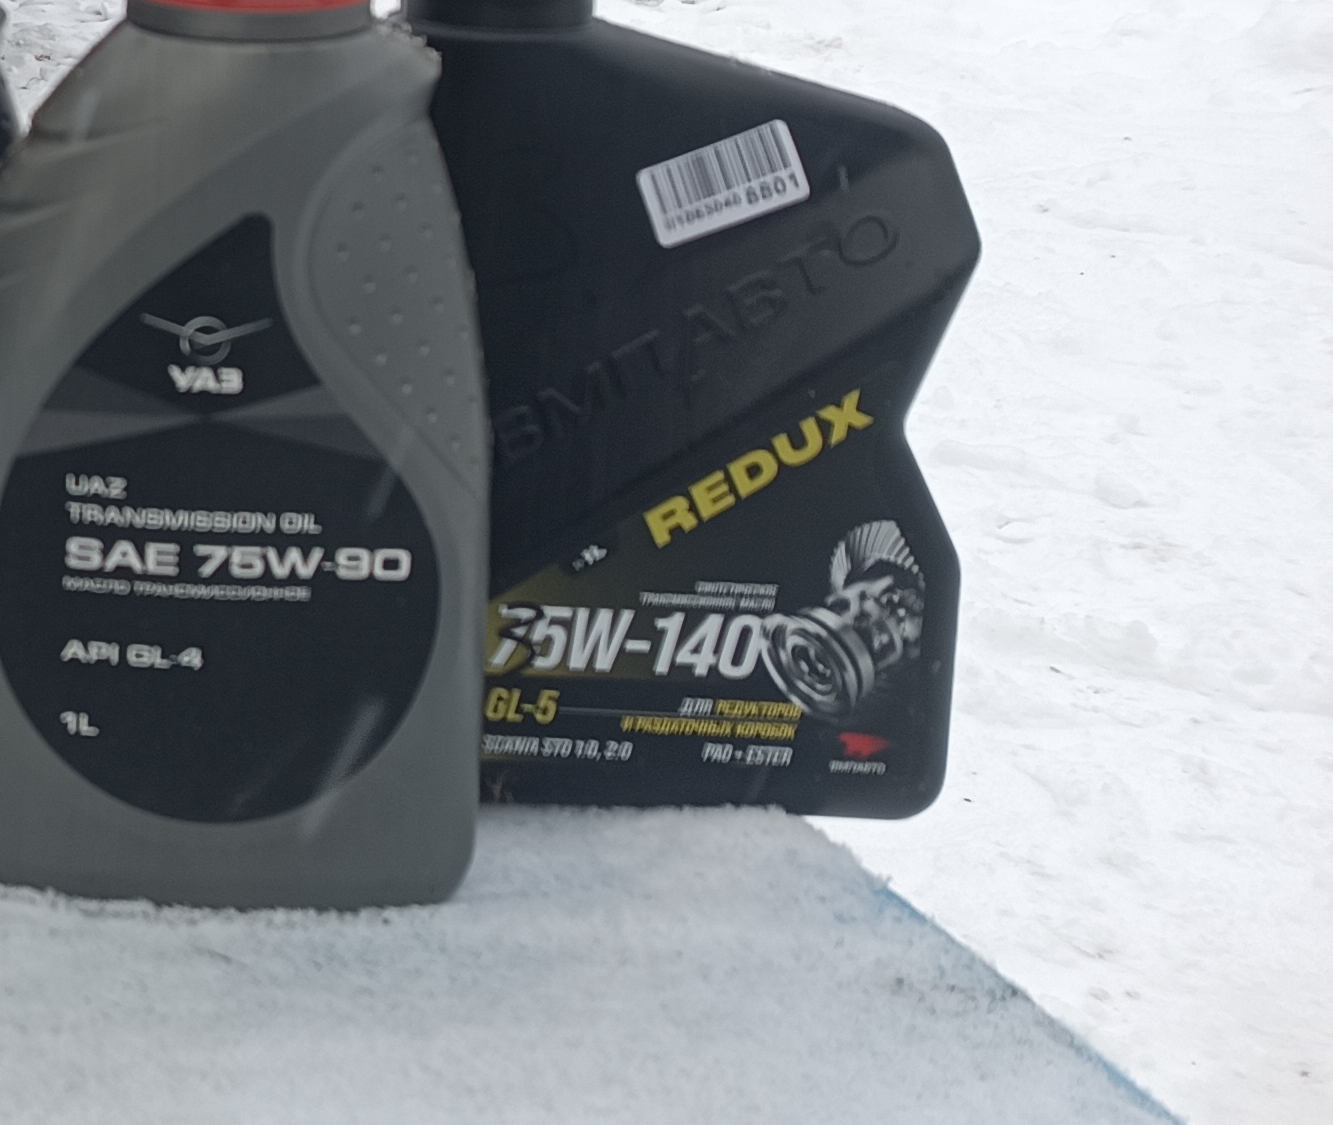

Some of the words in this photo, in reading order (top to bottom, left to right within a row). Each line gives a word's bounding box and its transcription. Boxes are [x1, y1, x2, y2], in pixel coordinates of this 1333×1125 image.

[167, 364, 244, 395] УАЗ
[643, 388, 874, 549] REDUX
[65, 473, 128, 499] UAZ
[65, 501, 275, 534] TRANSMISSION
[279, 511, 322, 535] OIL
[64, 536, 180, 576] SAE
[193, 545, 412, 582] 75W-90
[60, 639, 119, 666] API
[126, 644, 204, 671] GL-4
[485, 687, 560, 725] GL-5
[678, 698, 713, 717] ДЛЯ
[60, 711, 99, 737] 1L
